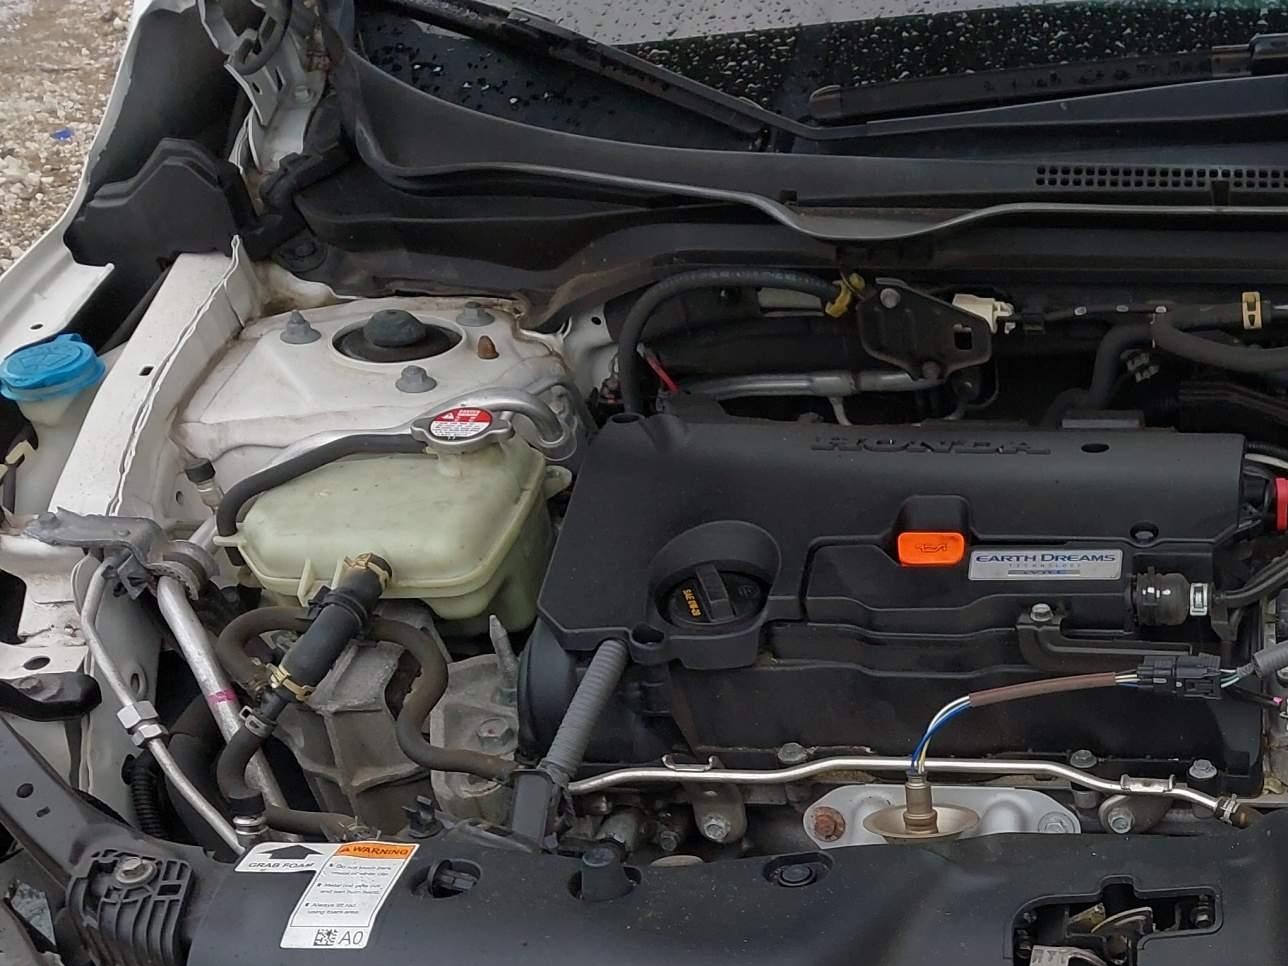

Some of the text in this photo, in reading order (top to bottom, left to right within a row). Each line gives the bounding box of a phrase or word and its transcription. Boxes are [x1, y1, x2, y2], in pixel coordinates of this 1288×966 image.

[975, 553, 1116, 562] EARTH DREAMS
[352, 845, 409, 856] WARNING
[337, 930, 364, 945] A0
